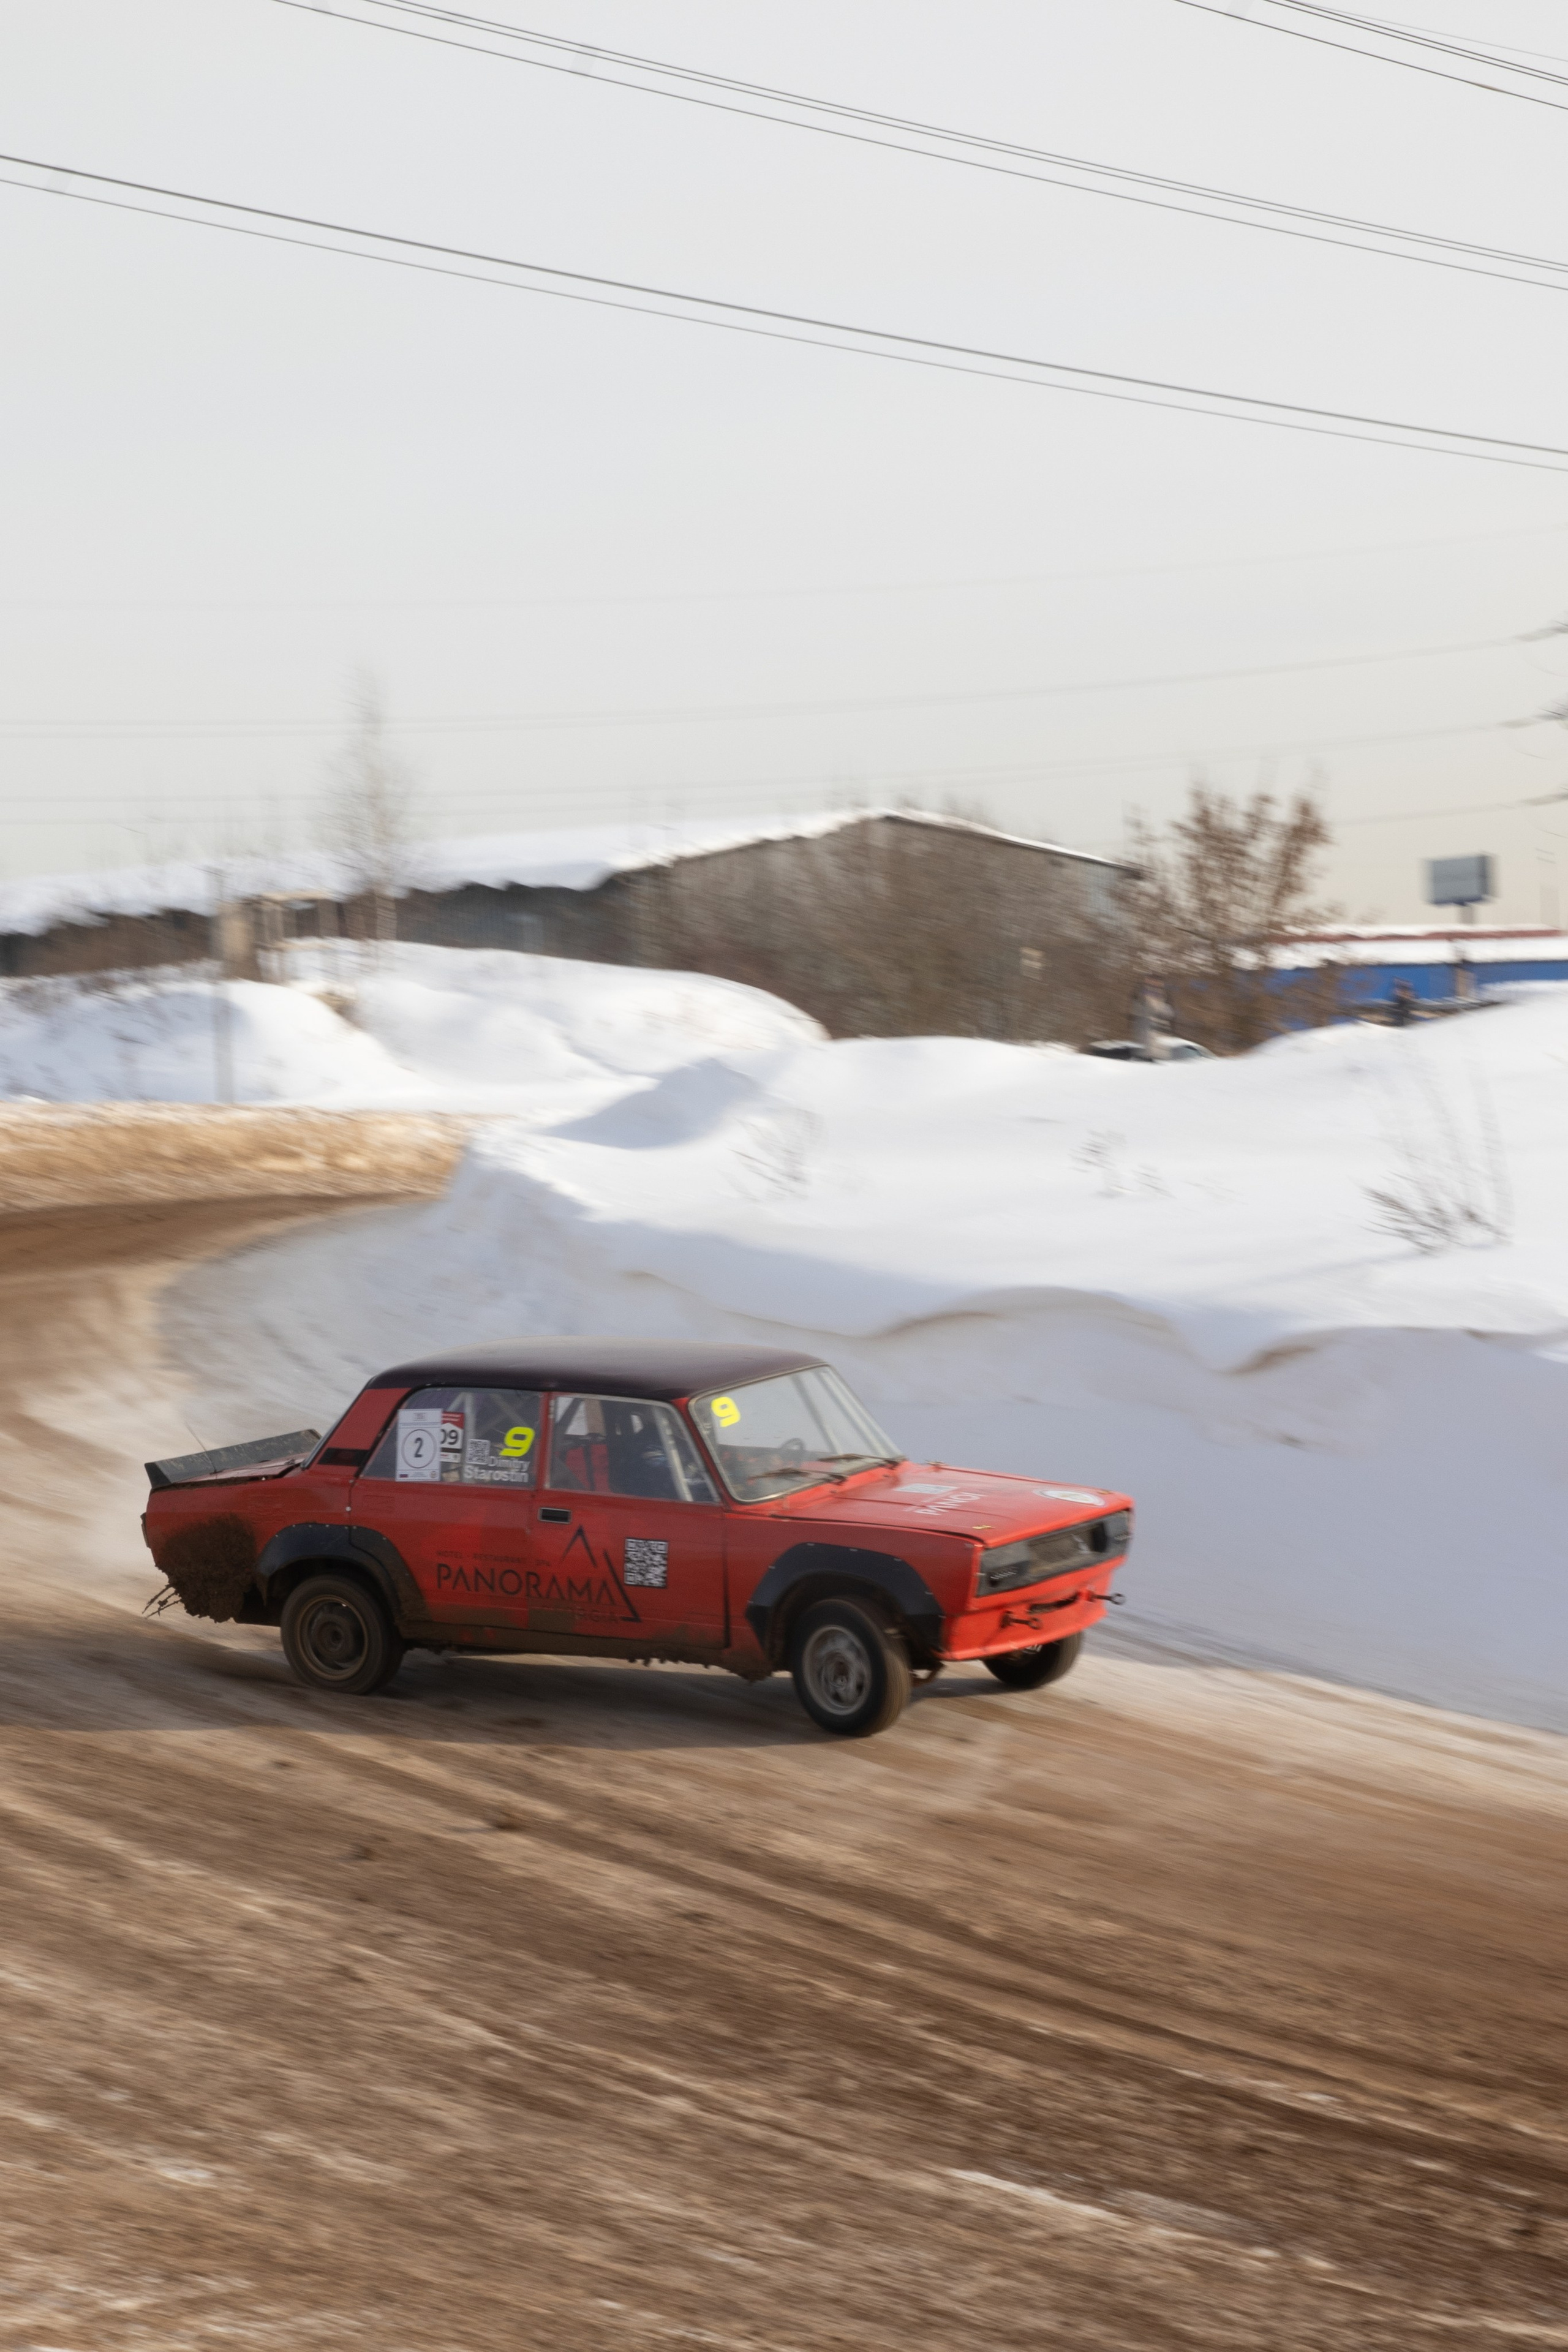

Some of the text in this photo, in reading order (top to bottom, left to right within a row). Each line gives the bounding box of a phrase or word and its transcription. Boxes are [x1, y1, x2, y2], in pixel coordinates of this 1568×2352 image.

[711, 1396, 741, 1428] 9
[413, 1437, 423, 1458] 2
[499, 1427, 535, 1457] 9
[463, 1464, 529, 1482] Starostin
[436, 1563, 617, 1606] PANORAMA
